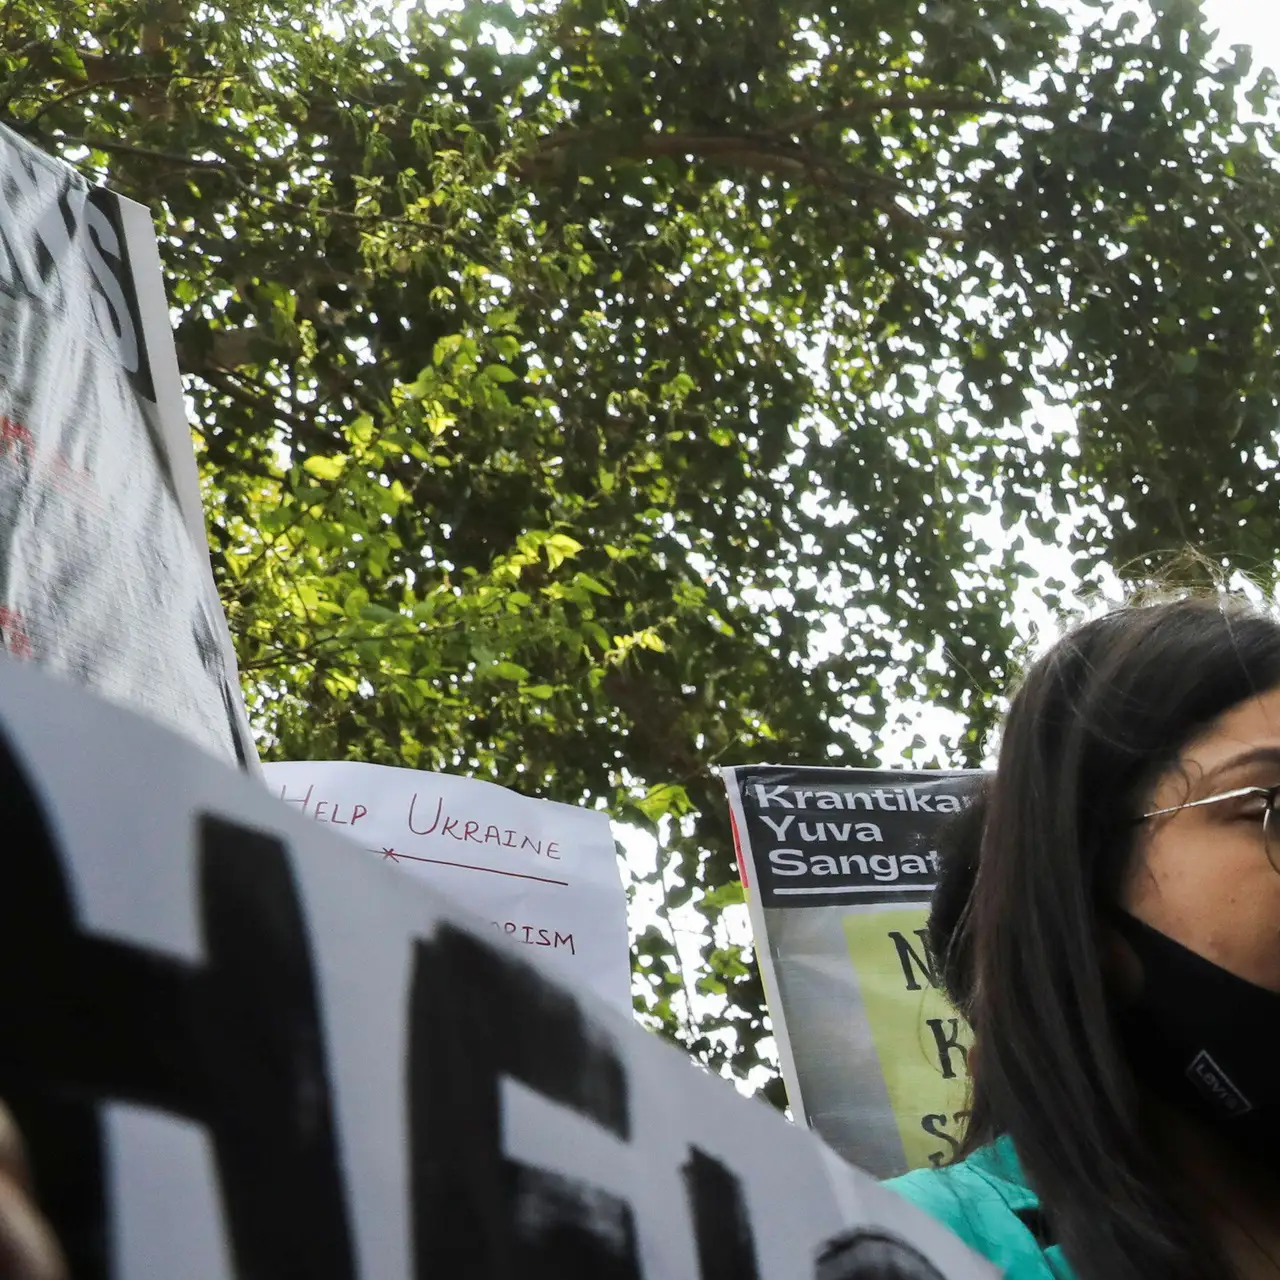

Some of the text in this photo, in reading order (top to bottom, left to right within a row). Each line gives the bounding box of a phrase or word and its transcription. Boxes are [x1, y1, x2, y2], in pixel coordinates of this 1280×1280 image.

[754, 783, 972, 813] Krantika
[279, 784, 562, 860] HELP UKRAINE
[759, 814, 884, 842] Yuva
[768, 849, 941, 881] Sangat
